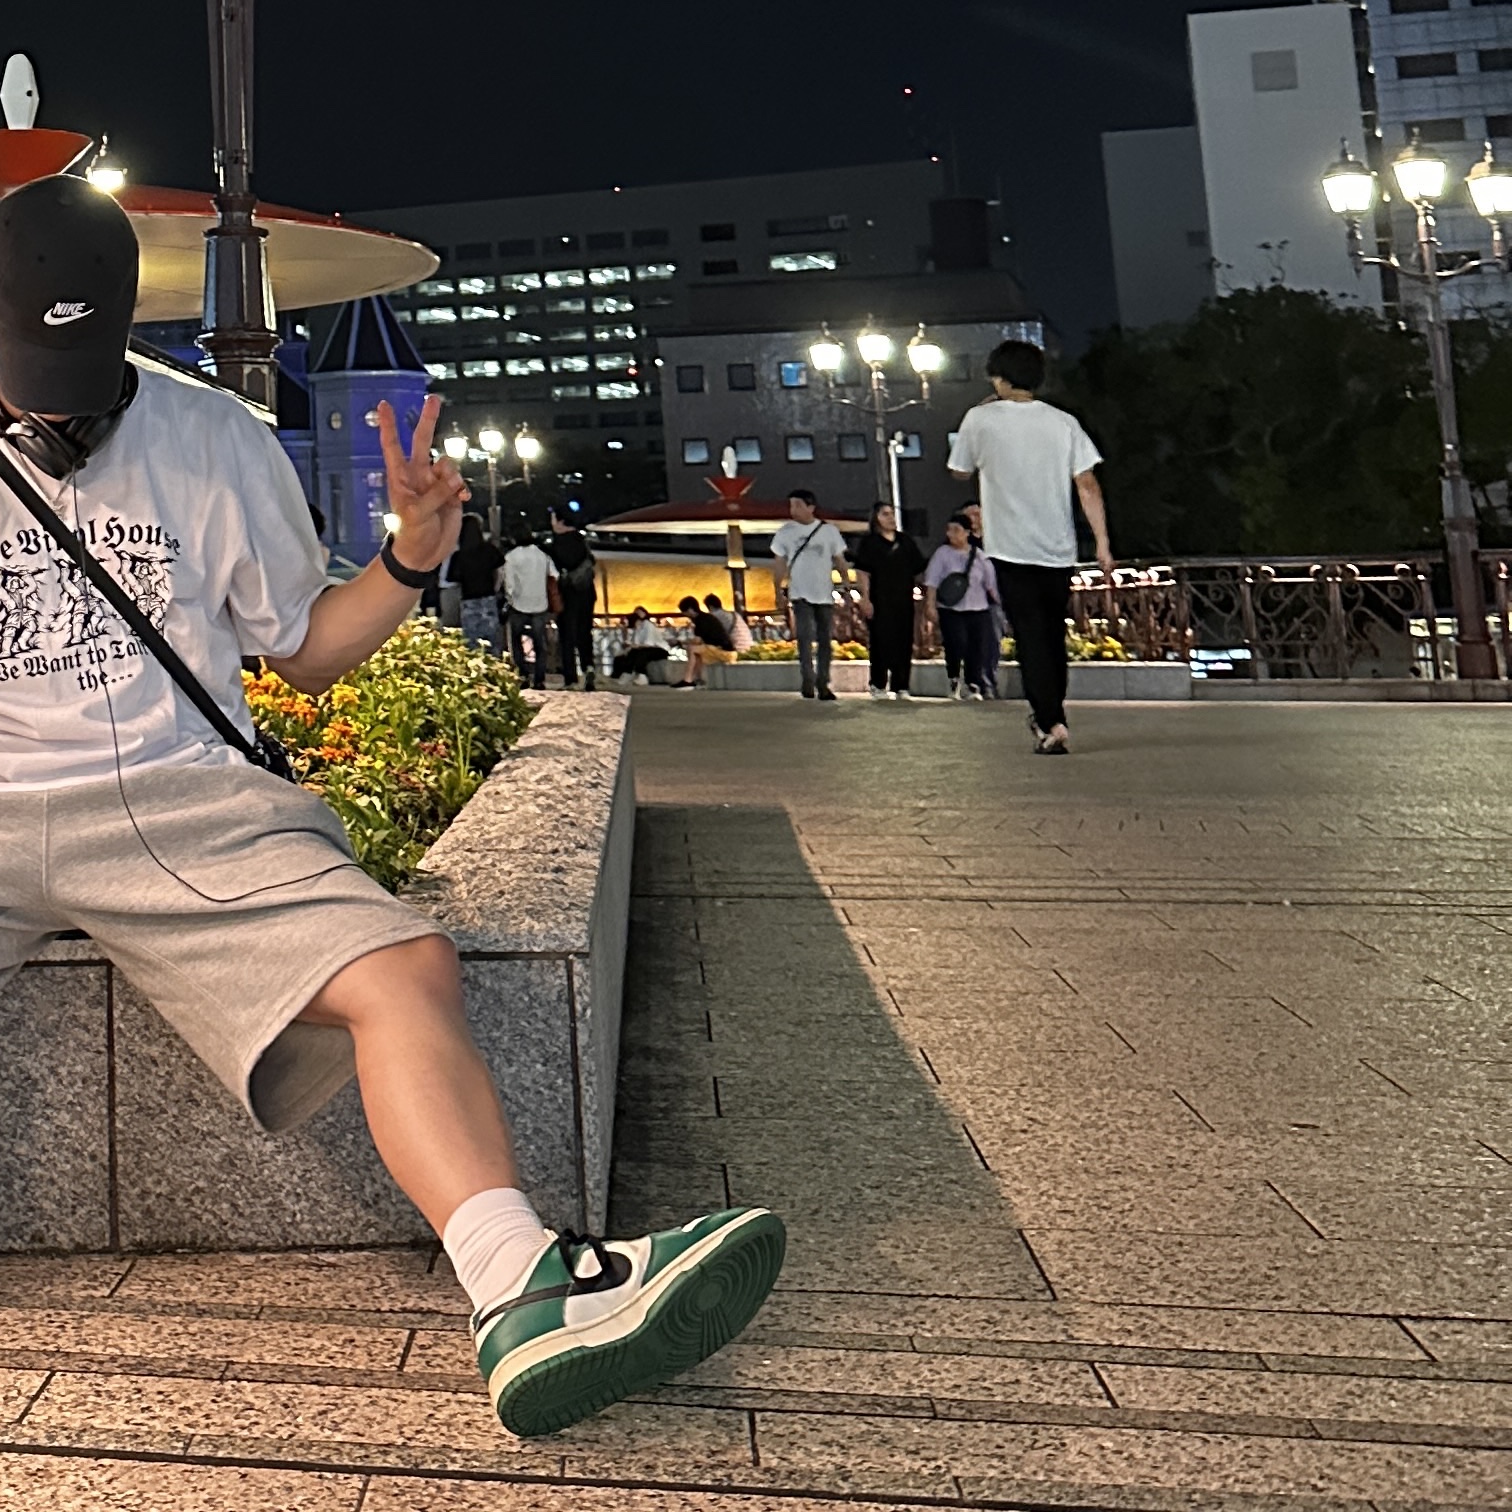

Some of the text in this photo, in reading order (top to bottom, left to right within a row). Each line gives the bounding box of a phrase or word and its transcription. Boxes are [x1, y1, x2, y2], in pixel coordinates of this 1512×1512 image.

[53, 301, 86, 316] NIKE
[16, 519, 97, 555] Vil
[101, 516, 180, 556] House
[23, 648, 81, 677] Want
[86, 645, 107, 665] to
